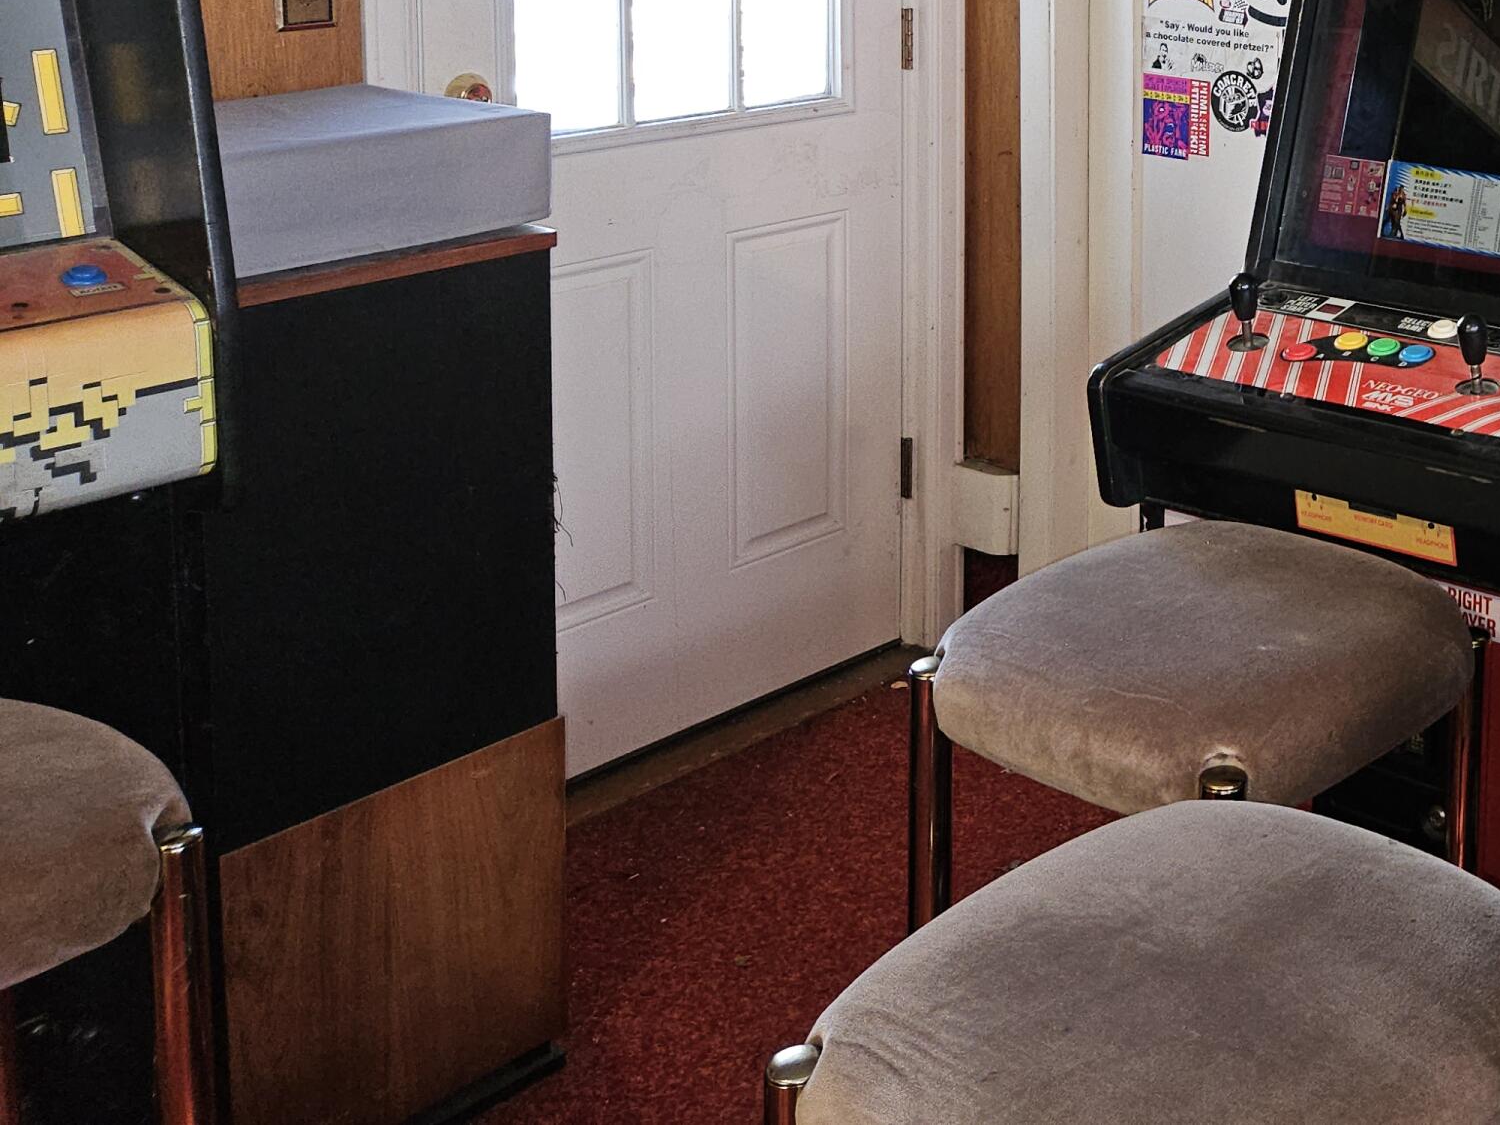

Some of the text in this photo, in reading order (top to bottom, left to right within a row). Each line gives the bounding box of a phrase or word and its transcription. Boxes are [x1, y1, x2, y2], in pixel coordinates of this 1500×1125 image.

[1187, 23, 1212, 34] Would
[1216, 28, 1231, 37] you
[1234, 29, 1249, 38] like
[1153, 31, 1194, 43] chocolate
[1196, 38, 1231, 48] covered
[1213, 74, 1258, 108] CONCRETE
[1144, 143, 1168, 155] PLASTIC
[1281, 305, 1308, 313] START
[1286, 300, 1317, 309] PLAYER
[1398, 323, 1425, 333] GAME
[1362, 391, 1413, 407] MVS
[1362, 402, 1395, 412] SNK
[1301, 511, 1332, 522] HEADPHONE
[1378, 520, 1393, 528] CARD
[1416, 538, 1449, 549] HEADPHONE
